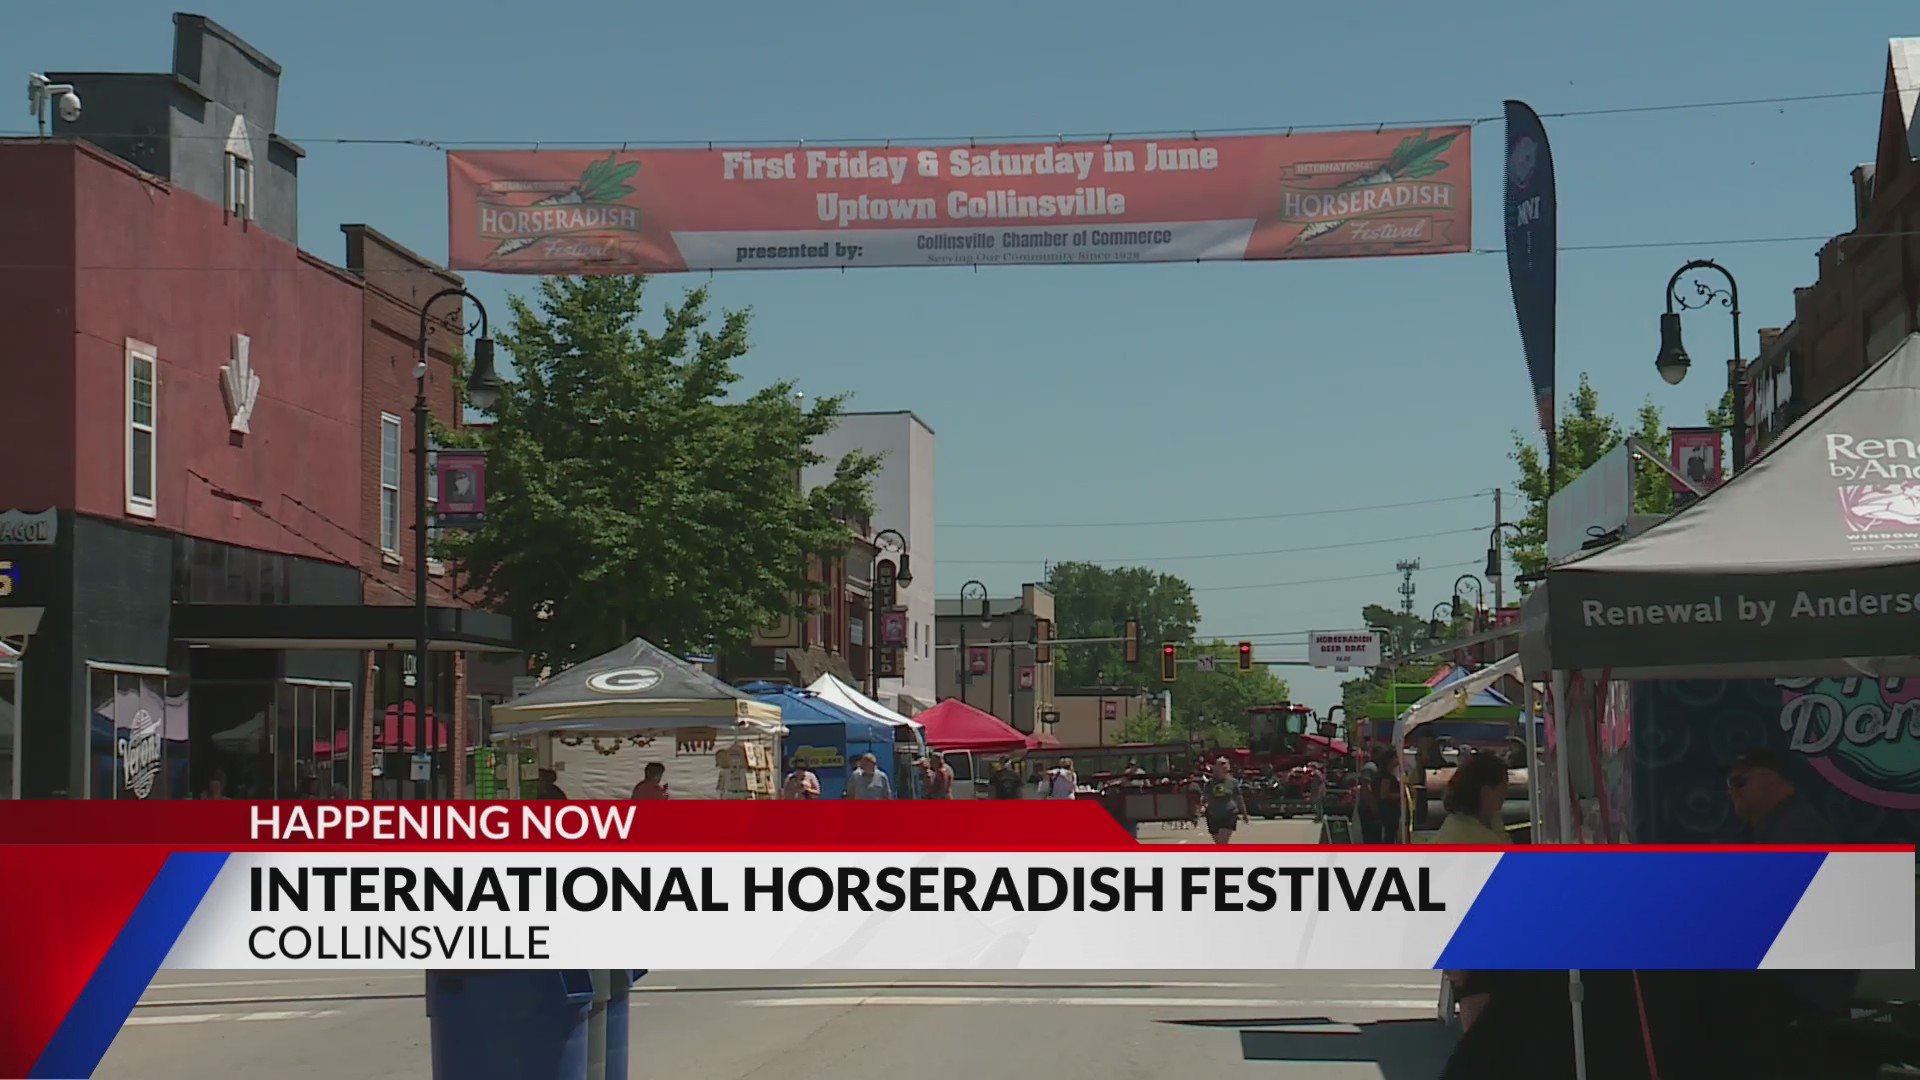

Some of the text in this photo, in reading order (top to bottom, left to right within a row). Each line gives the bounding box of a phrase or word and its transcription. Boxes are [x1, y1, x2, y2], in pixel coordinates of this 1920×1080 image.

[722, 142, 1219, 184] First Friday & Saturday in June
[816, 186, 1126, 227] Uptown Collinsville
[1284, 185, 1450, 218] HORSERADISH
[481, 207, 637, 234] HORSERADISH
[1350, 219, 1426, 241] Festival
[736, 241, 864, 263] presented by:
[917, 229, 1173, 250] Collinsville Chamber of Commerce
[927, 254, 976, 264] Serving
[976, 252, 1001, 262] Our
[1004, 251, 1075, 263] Community
[1078, 251, 1112, 261] Since
[1825, 433, 1920, 460] Ren
[1582, 596, 1722, 627] Renewal
[1738, 595, 1776, 626] by
